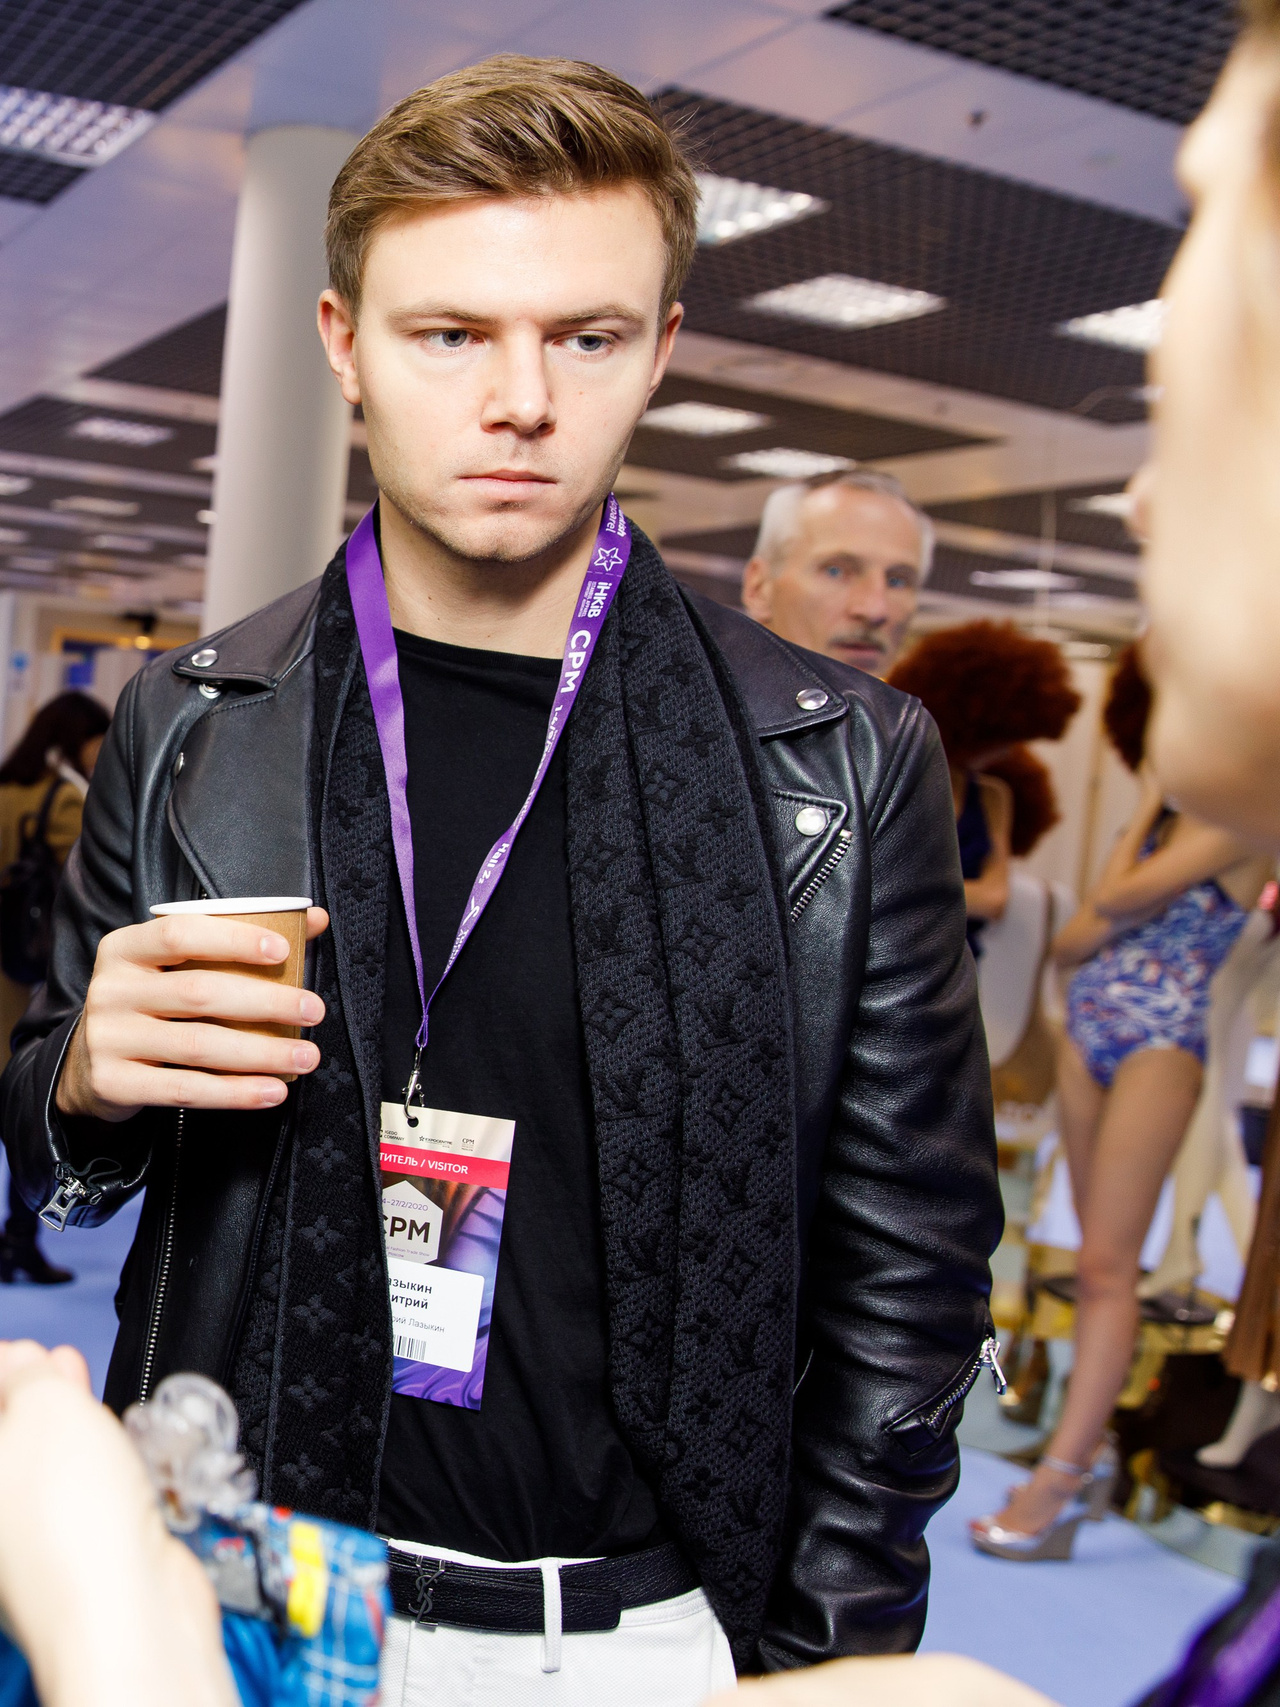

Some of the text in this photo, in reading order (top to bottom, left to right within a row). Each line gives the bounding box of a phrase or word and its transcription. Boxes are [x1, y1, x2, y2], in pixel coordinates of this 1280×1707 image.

[560, 629, 592, 694] CPM
[486, 843, 510, 868] Hall
[461, 1137, 475, 1145] CPM
[379, 1152, 419, 1167] ТИТЕЛЬ
[427, 1159, 469, 1175] VISITOR
[382, 1197, 429, 1212] 4-27/2/2020
[383, 1214, 431, 1244] PM
[388, 1277, 433, 1294] азыкин
[391, 1294, 429, 1310] итрий
[392, 1315, 445, 1333] рий Лазыкин
